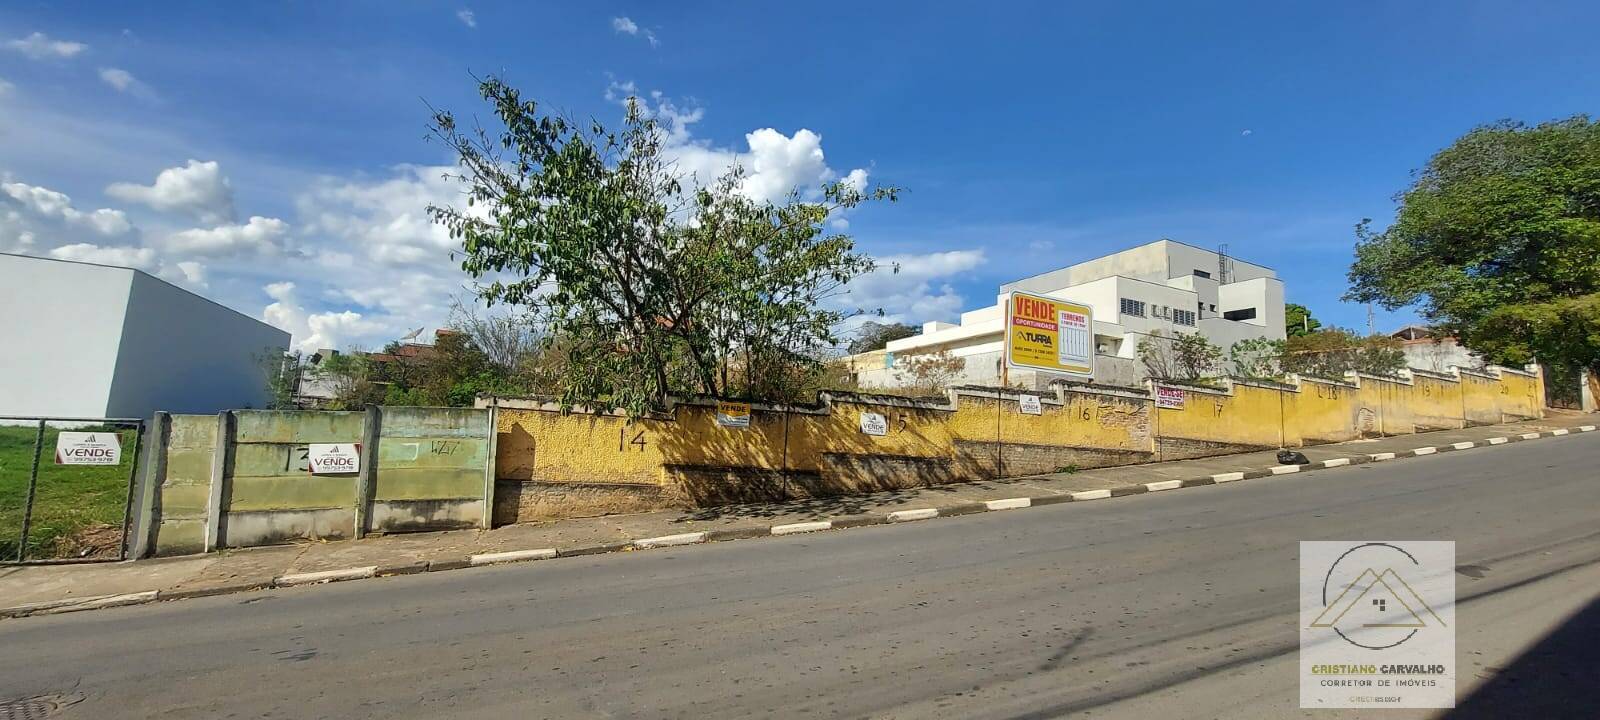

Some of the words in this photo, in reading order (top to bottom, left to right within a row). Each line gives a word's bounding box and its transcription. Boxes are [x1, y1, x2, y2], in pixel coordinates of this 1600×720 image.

[1015, 296, 1055, 321] VENDE
[1015, 318, 1056, 330] OPORTUNIDADE
[1025, 332, 1052, 345] TURRA
[720, 404, 747, 412] VENDE
[1078, 406, 1090, 420] 16
[863, 422, 885, 431] VENDE
[620, 428, 648, 452] 14
[64, 448, 114, 457] VENDE
[314, 458, 354, 466] VENDE
